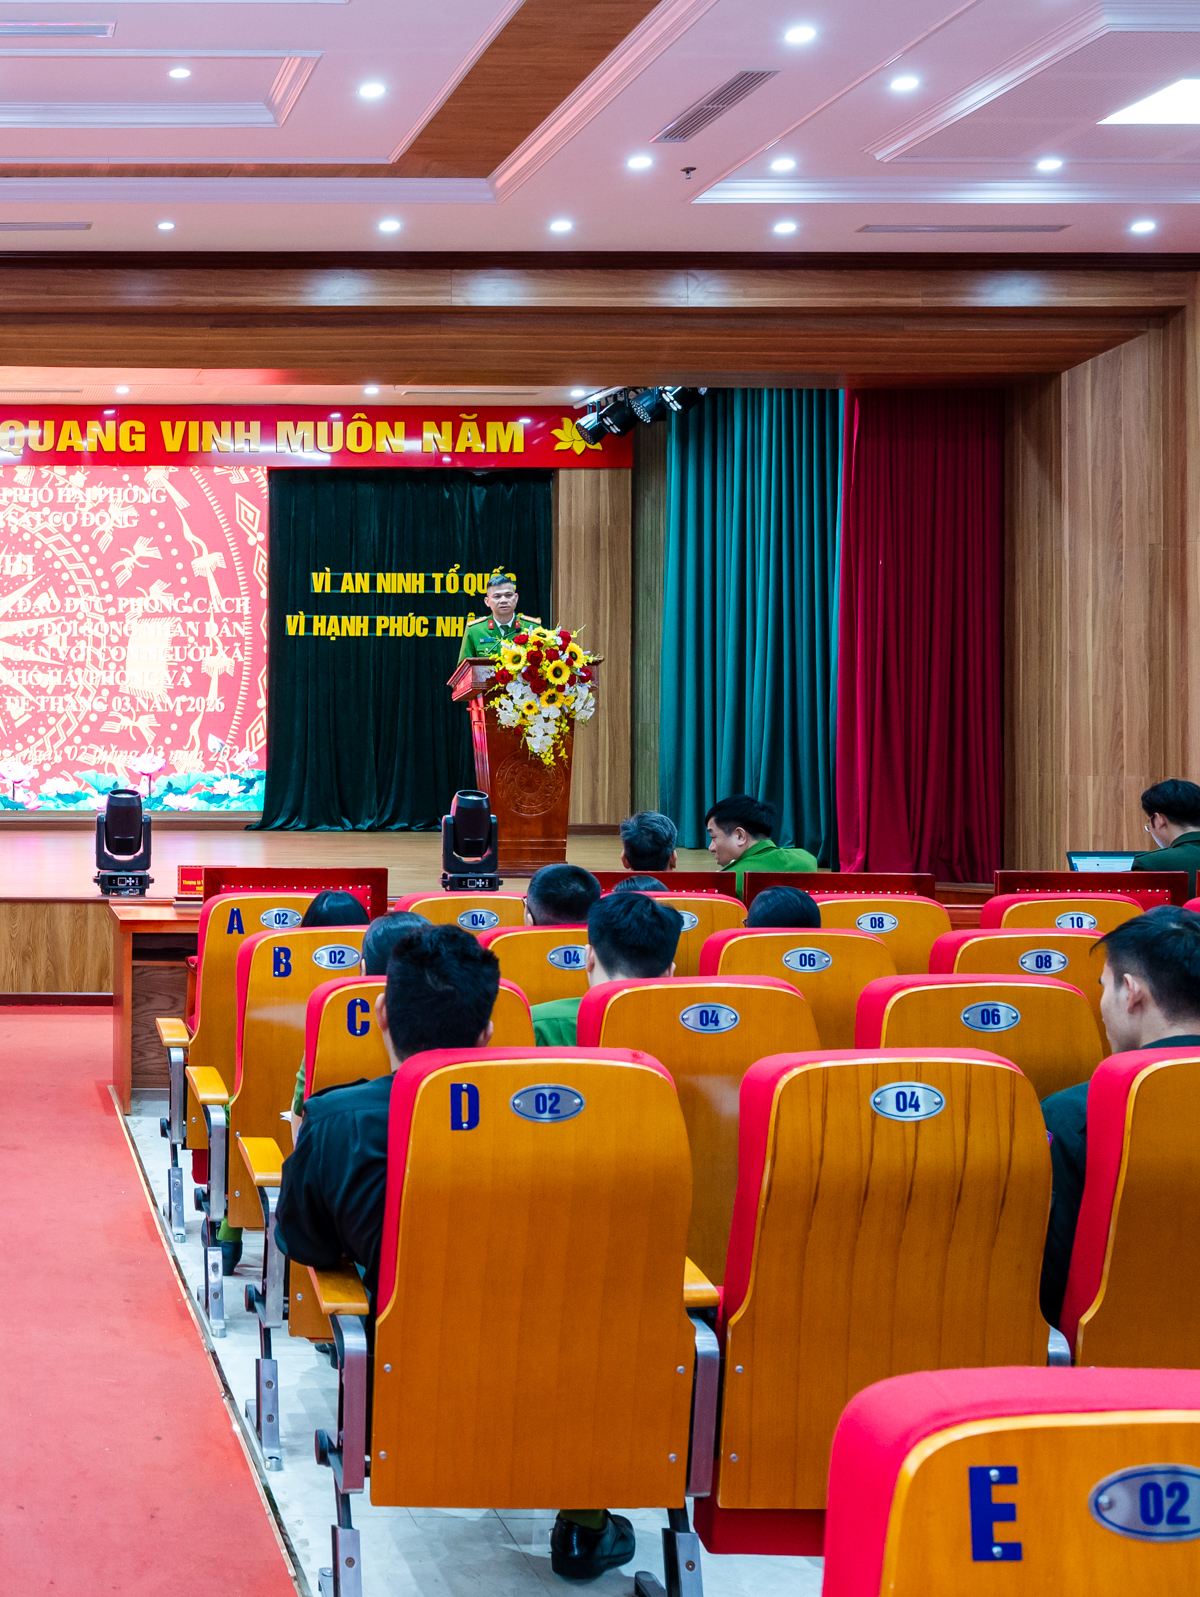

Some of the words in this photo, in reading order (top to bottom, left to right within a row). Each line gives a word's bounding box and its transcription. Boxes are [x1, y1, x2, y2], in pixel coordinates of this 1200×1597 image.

[0, 420, 146, 456] QUANG
[160, 420, 261, 452] VINH
[276, 413, 406, 453] MUÔN
[421, 413, 525, 453] NĂM
[97, 482, 167, 503] PHÒNG
[311, 567, 331, 593] VÌ
[341, 572, 370, 593] AN
[377, 572, 425, 594] NINH
[432, 563, 460, 594] TỔ
[464, 565, 517, 597] QU
[117, 597, 188, 613] PHONG
[204, 617, 245, 637] DÂN
[286, 611, 305, 636] VÌ
[313, 615, 369, 640] HẠNH
[376, 613, 428, 637] PHÚC
[215, 642, 245, 662] XÃ
[165, 665, 192, 686] VÀ
[112, 696, 131, 712] 03
[186, 696, 225, 712] 2026
[208, 745, 250, 762] 202
[227, 909, 244, 934] A
[274, 912, 289, 925] 02
[470, 913, 486, 927] 04
[869, 916, 885, 929] 08
[1069, 916, 1084, 929] 10
[274, 947, 291, 977] B
[328, 949, 346, 965] 02
[563, 949, 581, 965] 04
[799, 952, 816, 968] 06
[1035, 954, 1052, 970] 08
[348, 999, 370, 1036] C
[699, 1009, 720, 1027] 04
[980, 1007, 1001, 1026] 06
[451, 1084, 479, 1130] D
[535, 1093, 560, 1115] 02
[895, 1090, 921, 1113] 04
[969, 1466, 1022, 1561] E
[1139, 1483, 1190, 1525] 02
